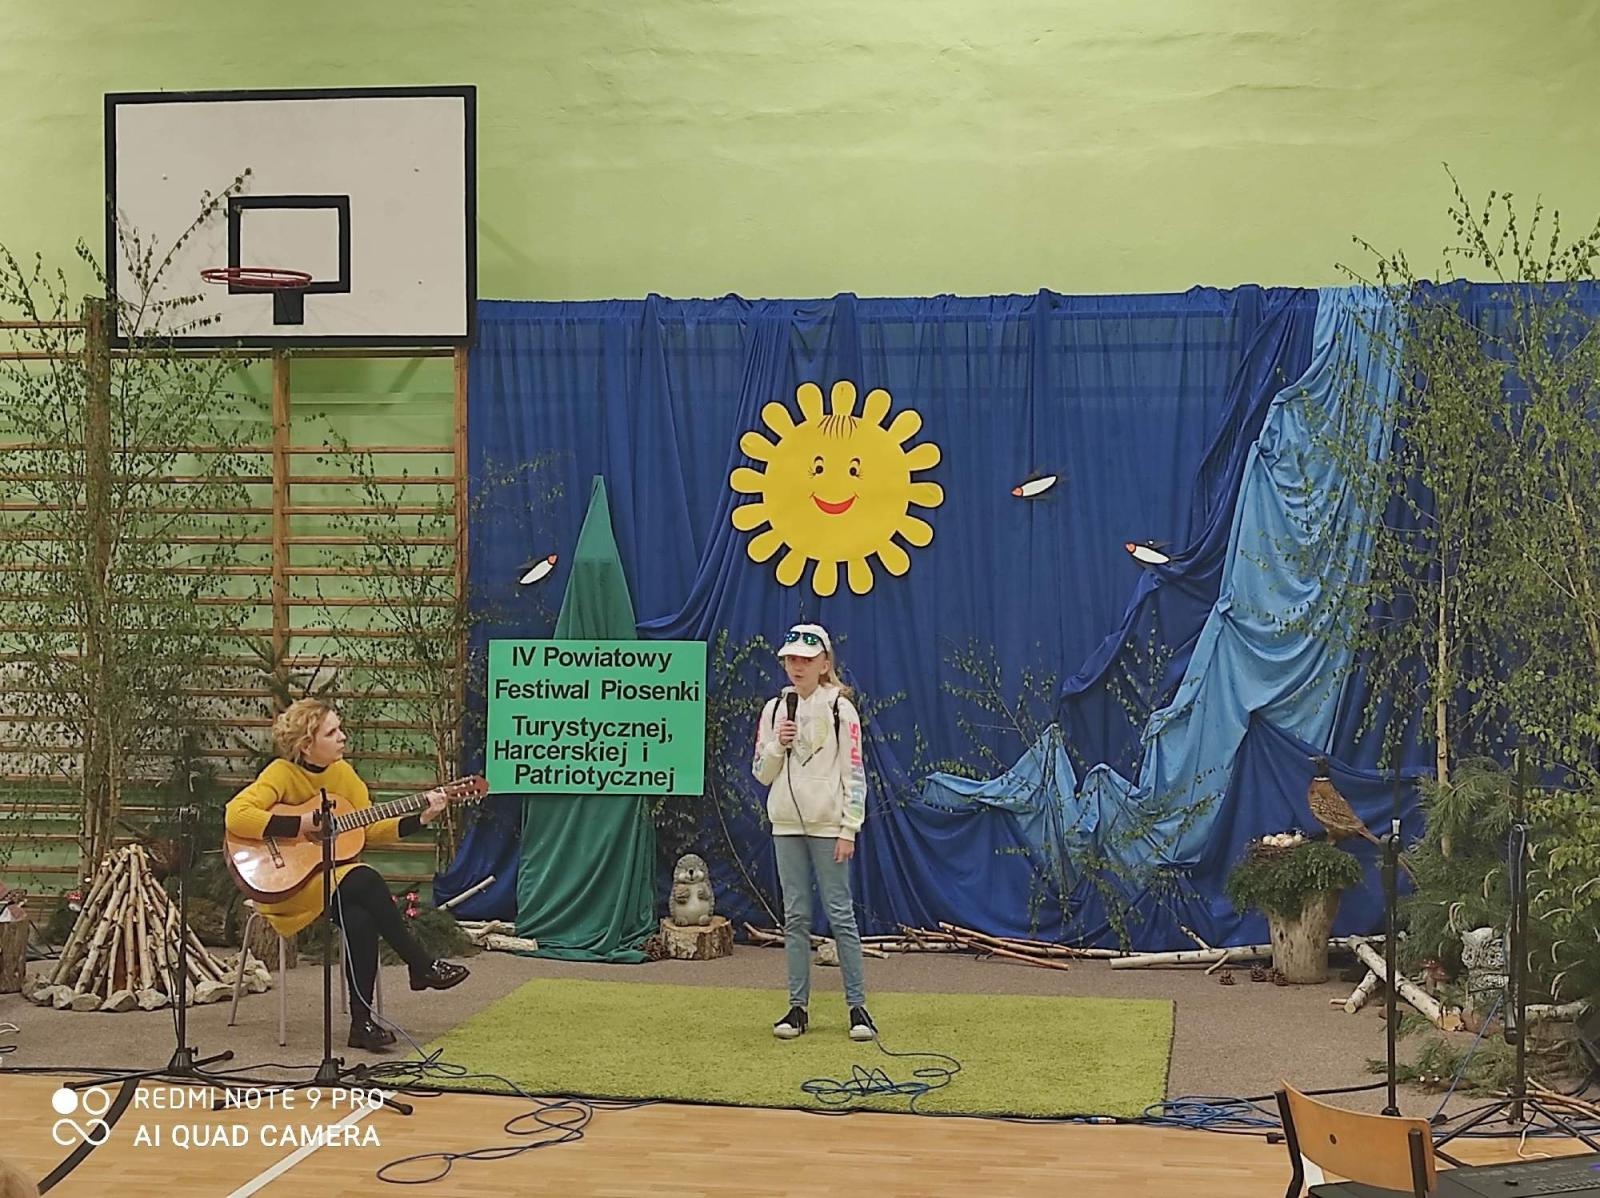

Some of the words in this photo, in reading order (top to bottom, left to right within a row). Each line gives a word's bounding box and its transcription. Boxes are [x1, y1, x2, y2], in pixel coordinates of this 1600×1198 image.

[512, 646, 537, 667] IV
[543, 646, 672, 673] Powiatowy
[495, 679, 590, 700] Festiwal
[601, 680, 700, 702] Piosenki
[512, 715, 673, 744] Turystycznej,
[494, 740, 628, 767] Harcerskiej
[642, 742, 648, 762] i
[514, 764, 675, 793] Patriotycznej
